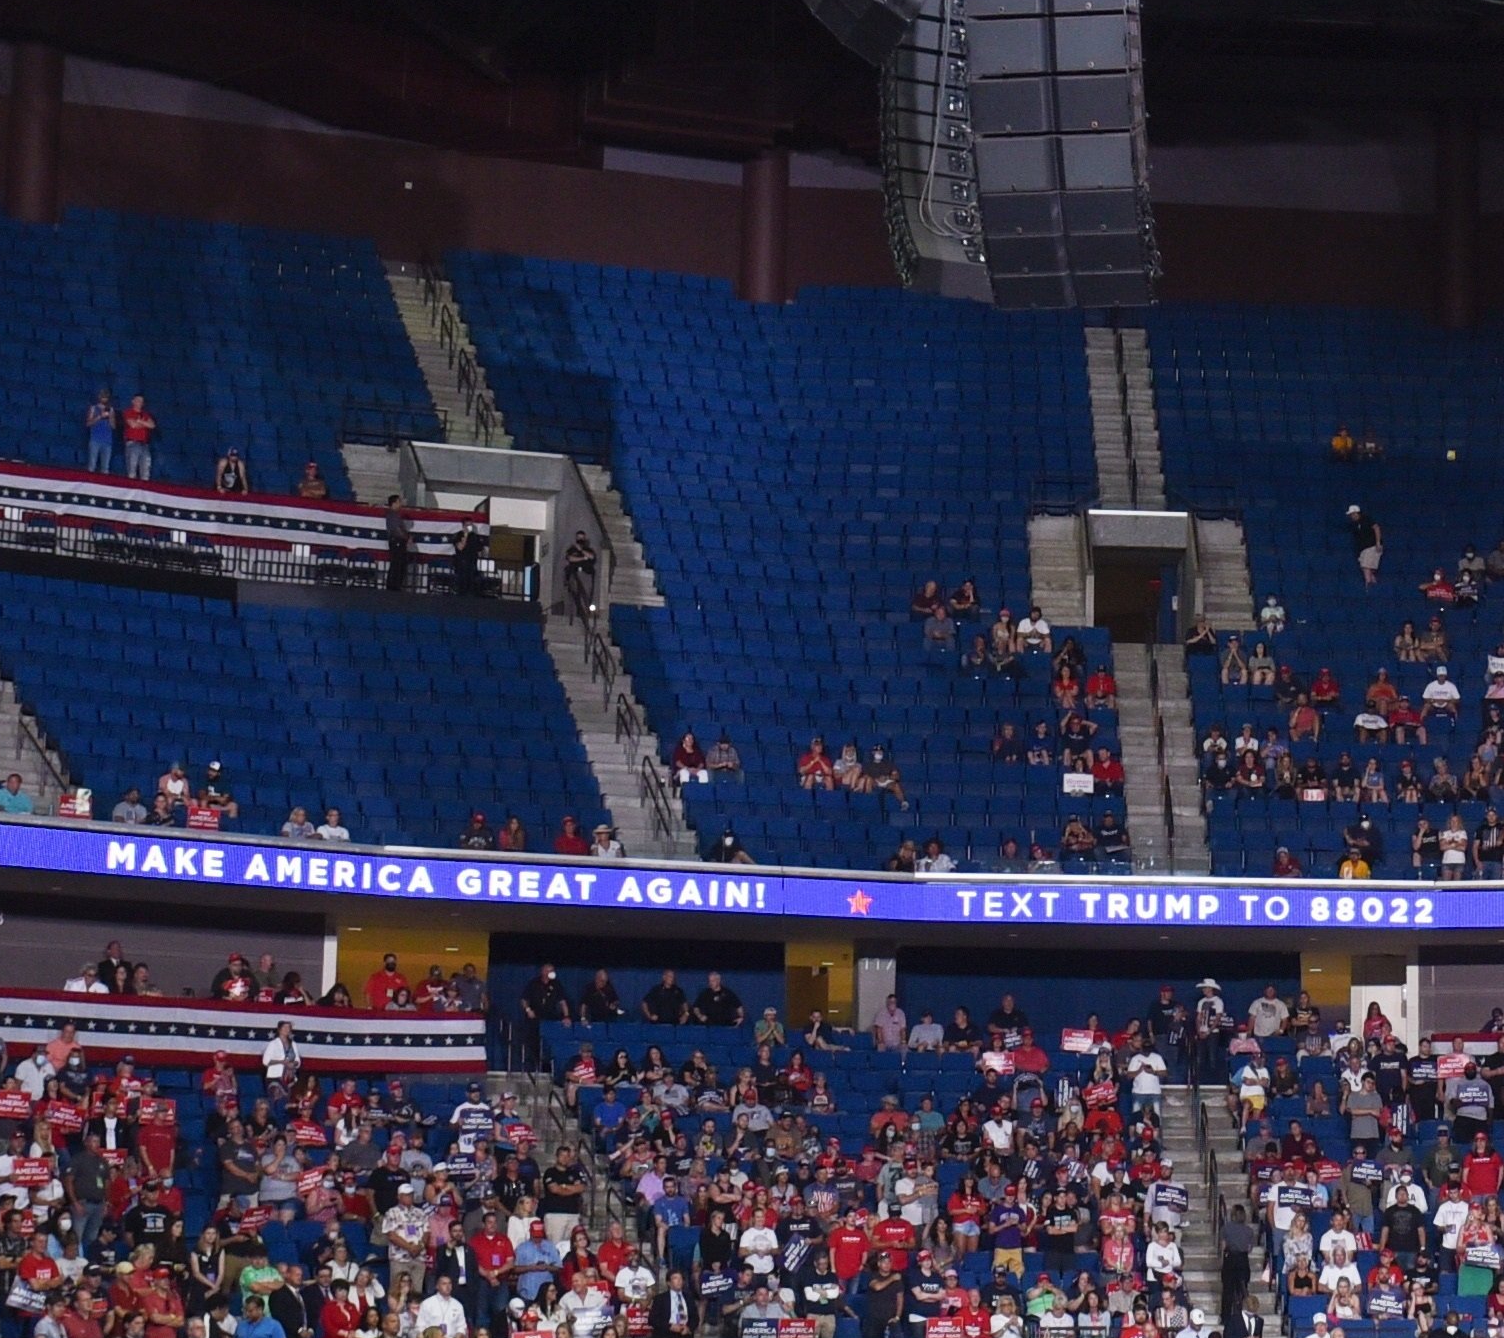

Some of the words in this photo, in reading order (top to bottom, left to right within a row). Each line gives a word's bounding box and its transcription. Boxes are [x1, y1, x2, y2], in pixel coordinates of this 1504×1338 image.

[107, 841, 225, 878] MAKE
[244, 853, 434, 894] AMERICA
[456, 868, 597, 901] GREAT
[617, 876, 765, 909] AGAIN!
[956, 890, 1060, 918] TEXT
[1079, 892, 1219, 920] TRUMP
[1238, 894, 1290, 922] TO
[1310, 896, 1435, 924] 88022
[1460, 1090, 1488, 1099] AMERICA
[15, 1167, 48, 1176] AMERICA
[1280, 1192, 1311, 1202] AMERICA
[1372, 1298, 1403, 1310] AMERICA
[744, 1327, 778, 1336] AMERICA
[780, 1327, 814, 1336] AMERICA
[928, 1326, 962, 1335] AMERICA
